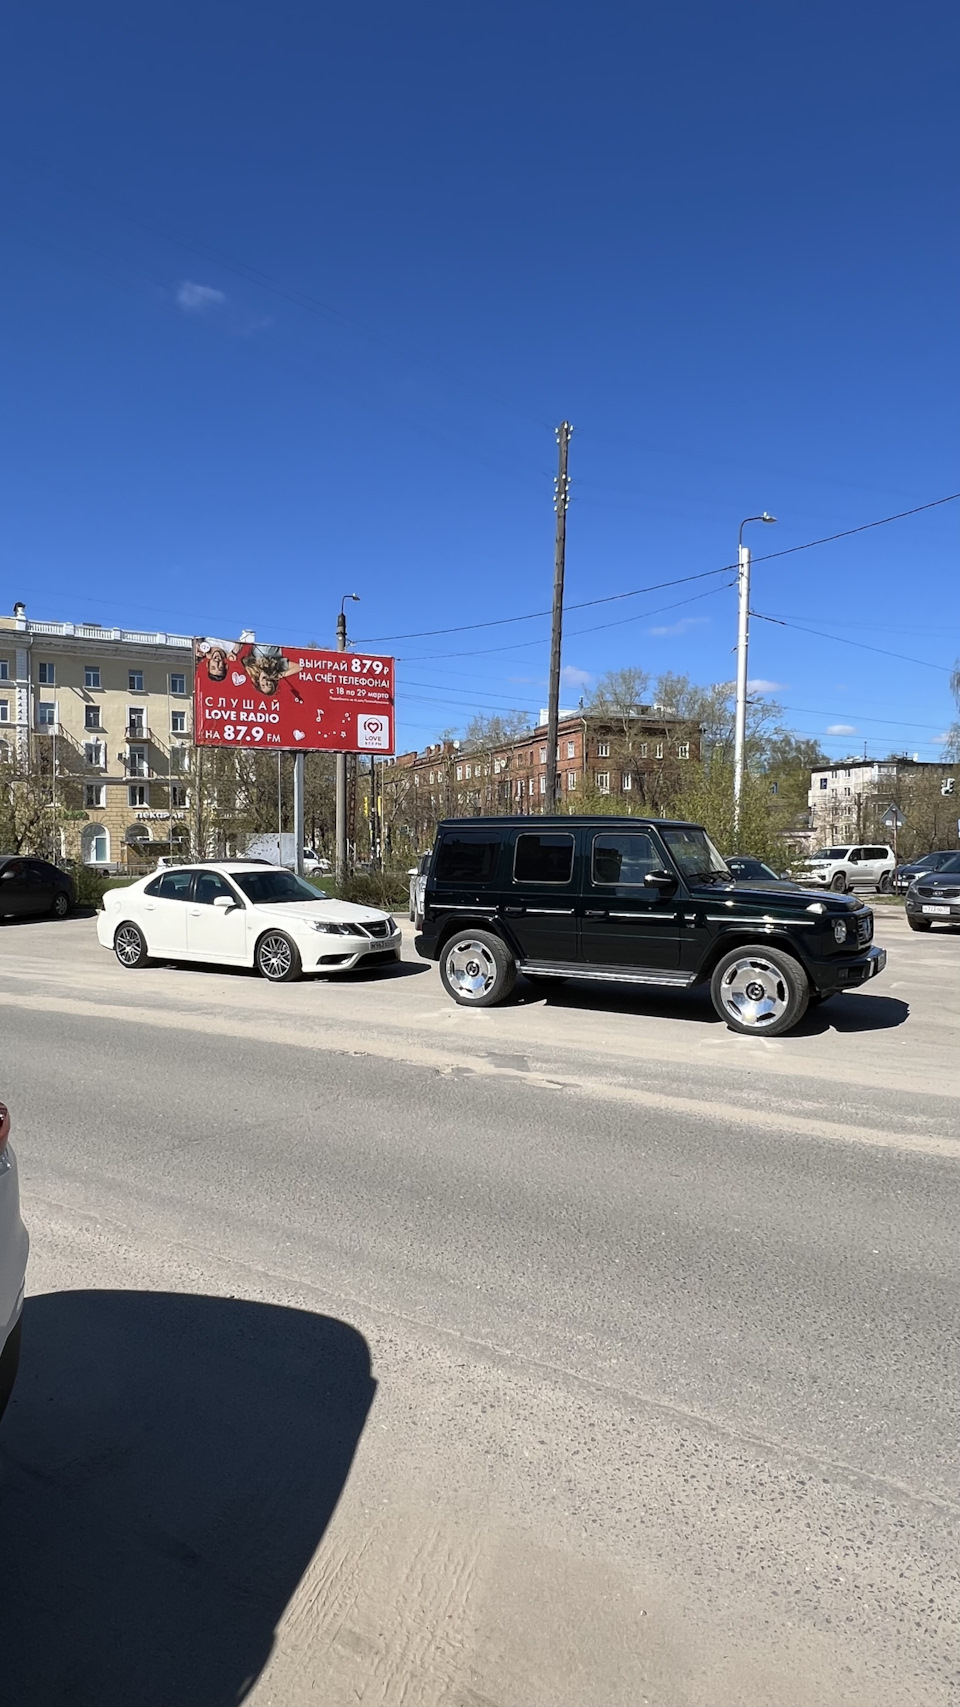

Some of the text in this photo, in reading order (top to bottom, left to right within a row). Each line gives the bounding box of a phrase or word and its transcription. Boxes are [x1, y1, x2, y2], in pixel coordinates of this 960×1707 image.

[299, 658, 348, 671] ВЫИГРАЙ
[299, 672, 390, 688] НА СЧЁТ ТЕЛЕФОНА!
[336, 687, 345, 695] 18
[357, 689, 367, 697] 29
[205, 696, 280, 711] СЛУШАЙ
[205, 709, 280, 724] LOVE RADIO
[205, 724, 281, 743] НА 87.9 FM
